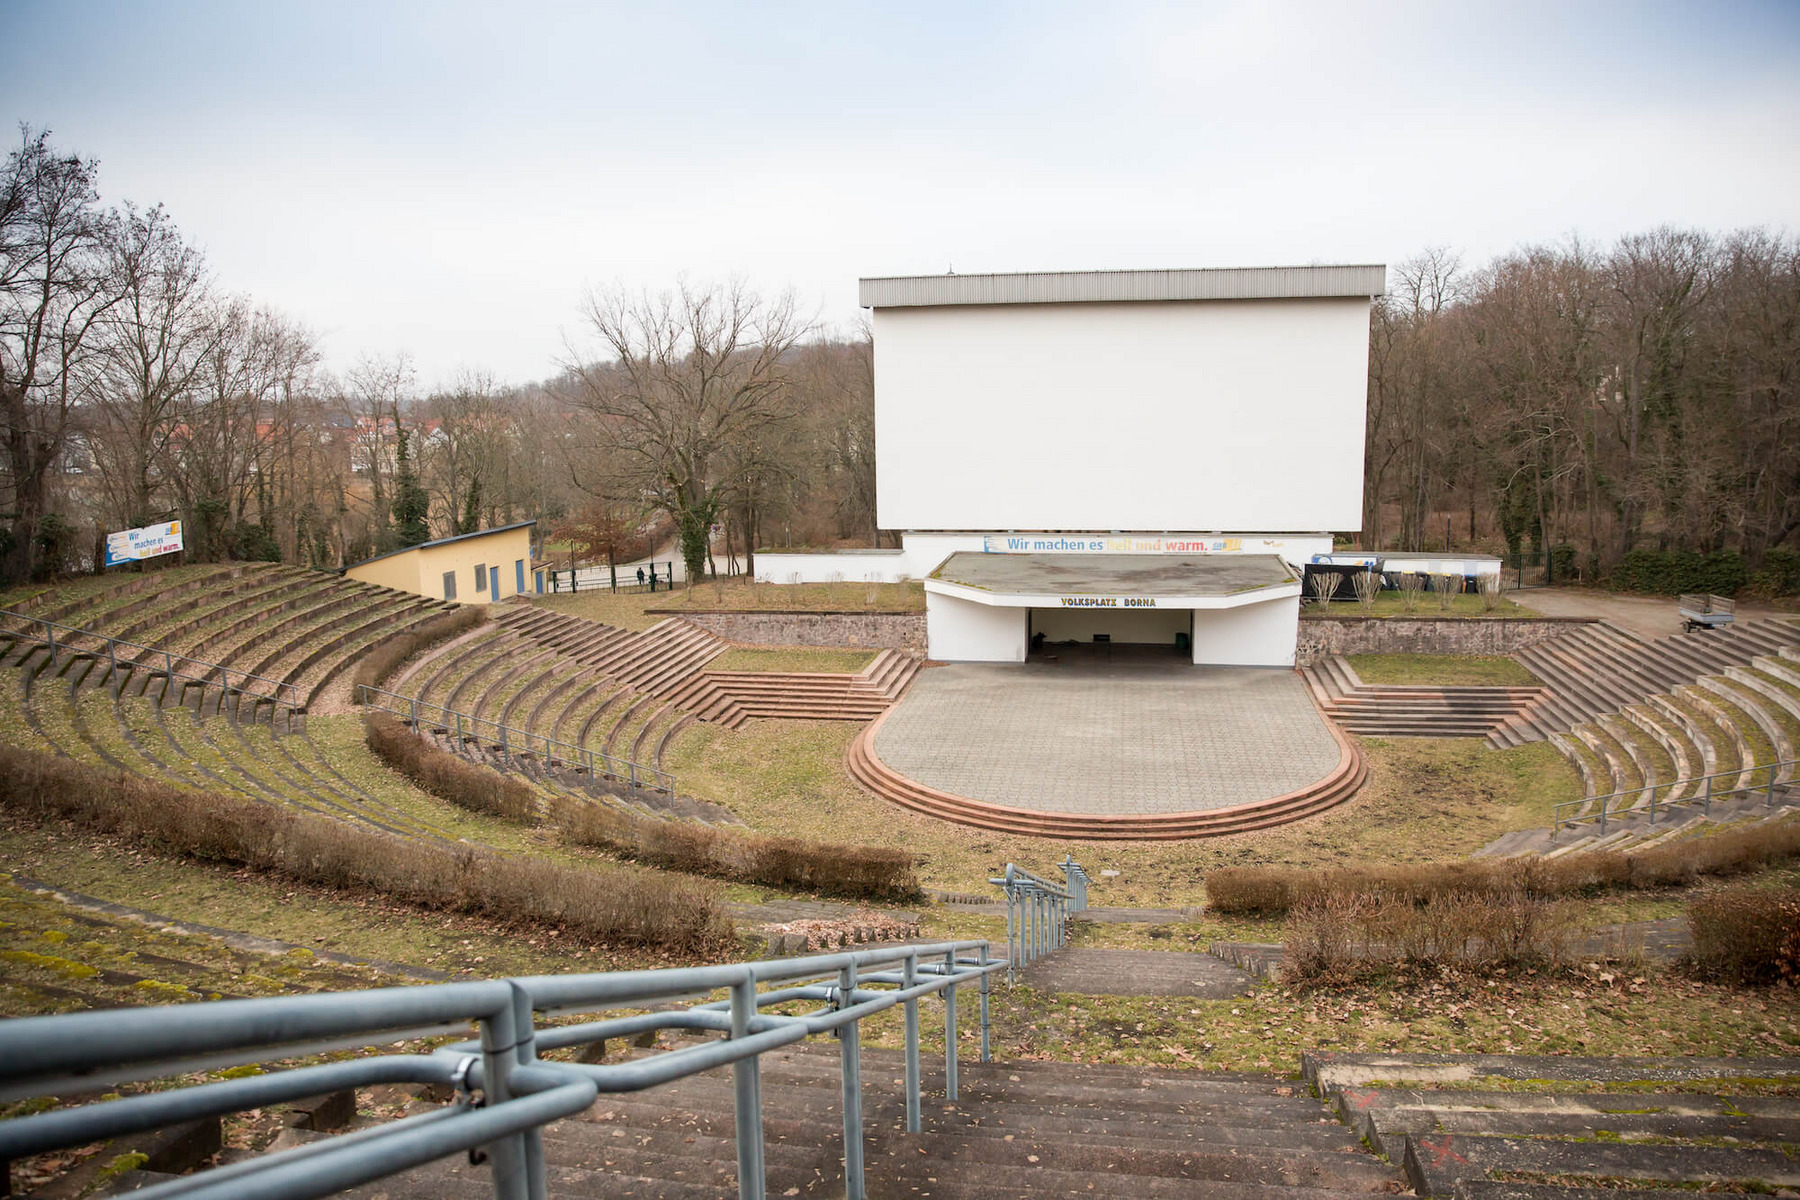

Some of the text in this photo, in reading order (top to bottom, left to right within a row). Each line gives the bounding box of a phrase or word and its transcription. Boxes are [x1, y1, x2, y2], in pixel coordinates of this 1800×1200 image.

[128, 532, 139, 541] Wir
[134, 537, 156, 549] machen
[1007, 538, 1030, 550] Wir
[1033, 538, 1085, 551] machen
[1089, 541, 1104, 551] es
[1107, 538, 1132, 551] hell
[1136, 539, 1162, 551] und
[1165, 540, 1208, 551] warm.
[152, 545, 162, 555] und
[1061, 598, 1156, 606] VOLKSPLATZ BORNA
